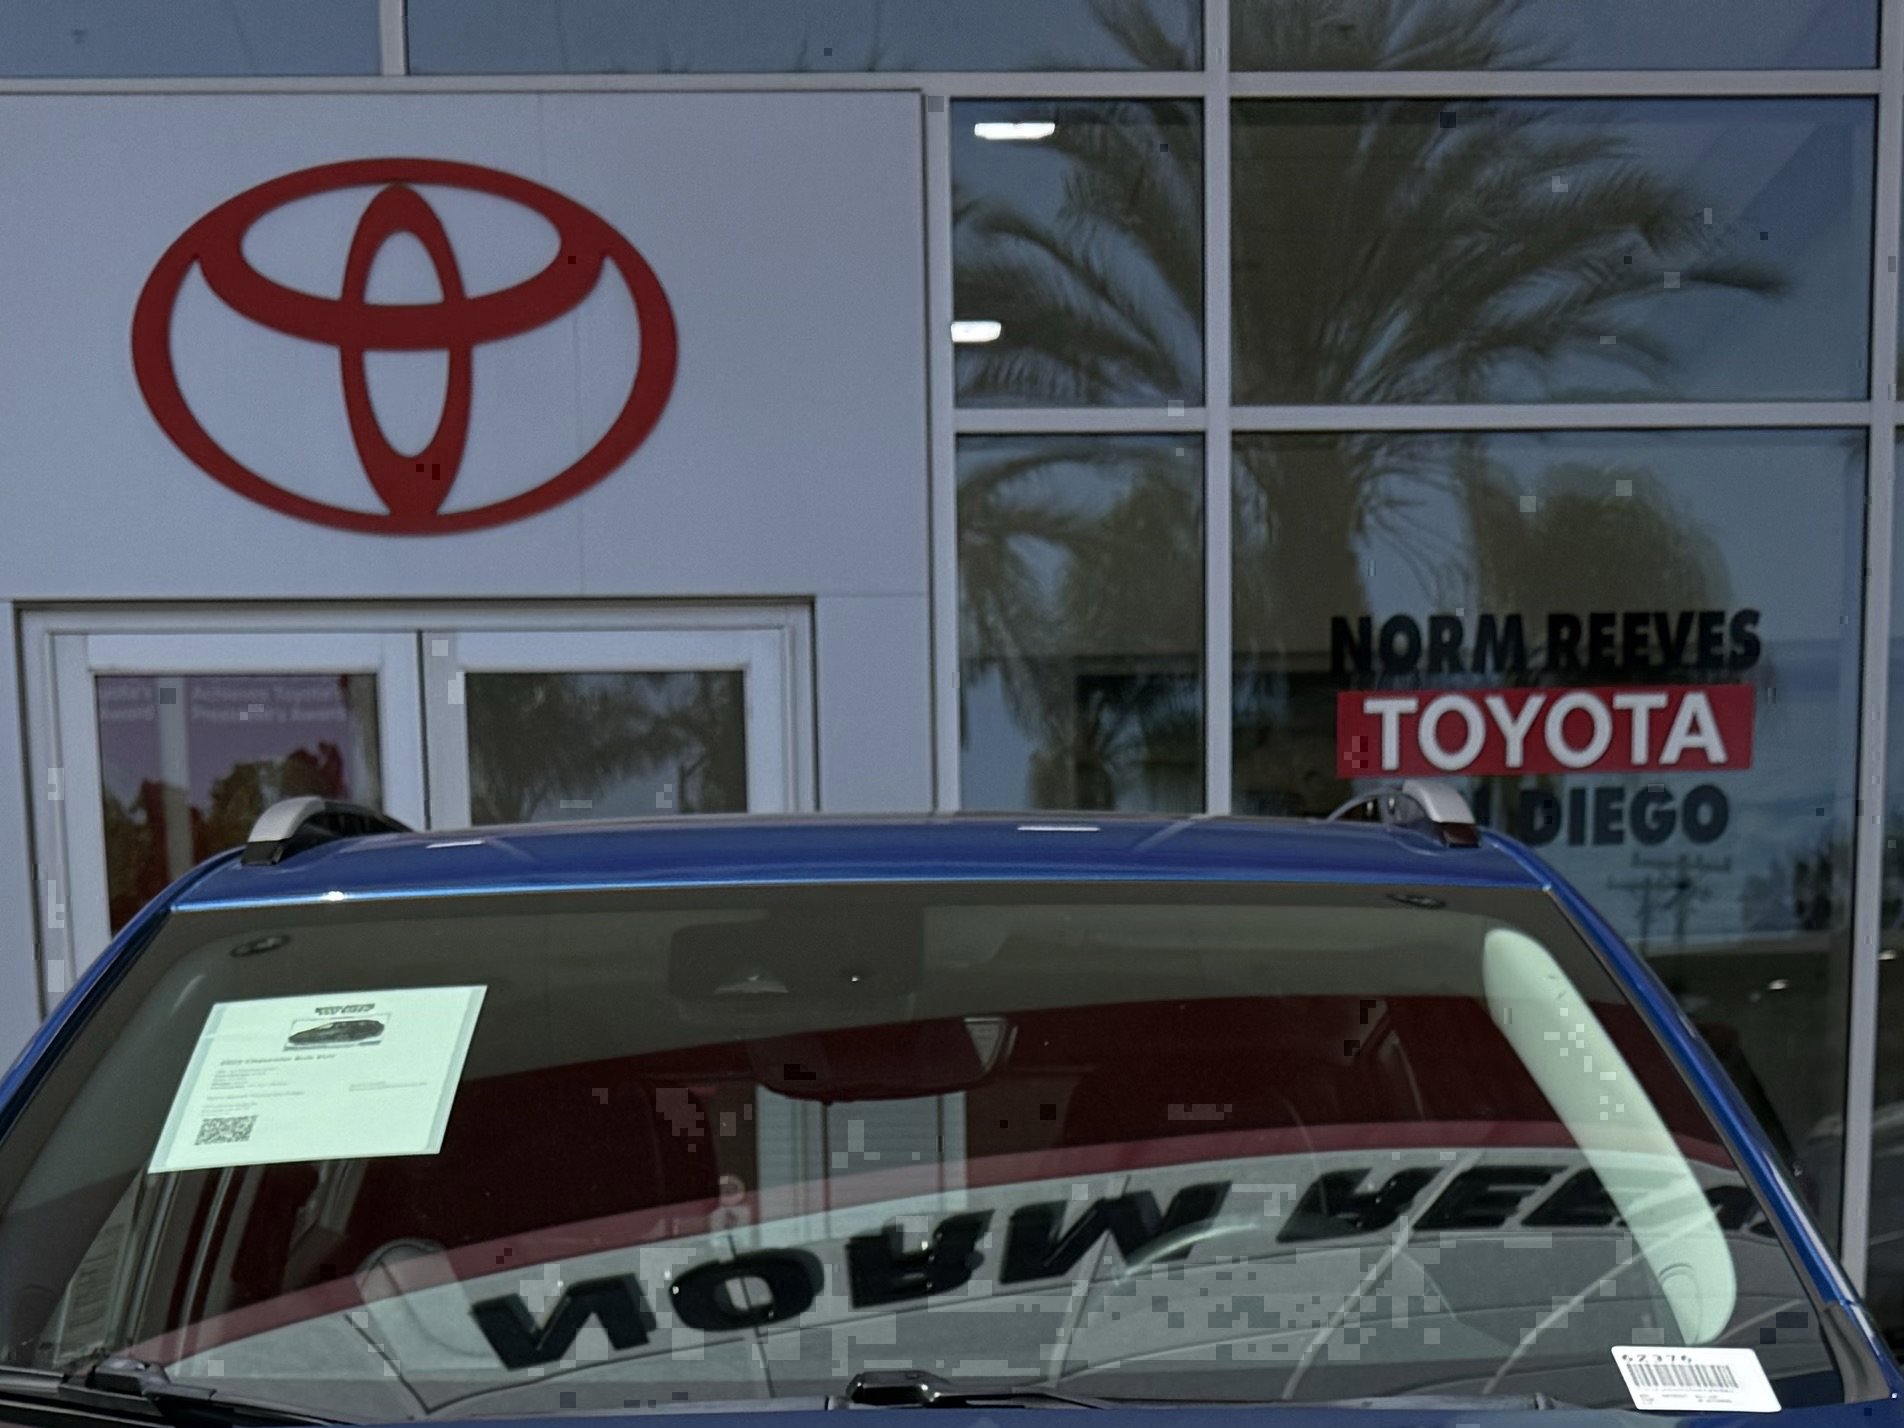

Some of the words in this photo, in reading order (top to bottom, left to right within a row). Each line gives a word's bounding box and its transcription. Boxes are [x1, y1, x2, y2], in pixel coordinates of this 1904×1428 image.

[1330, 612, 1528, 676] NORM
[1545, 608, 1762, 672] REEVES
[1363, 691, 1728, 772] TOYOTA
[1519, 784, 1730, 849] DIEGO
